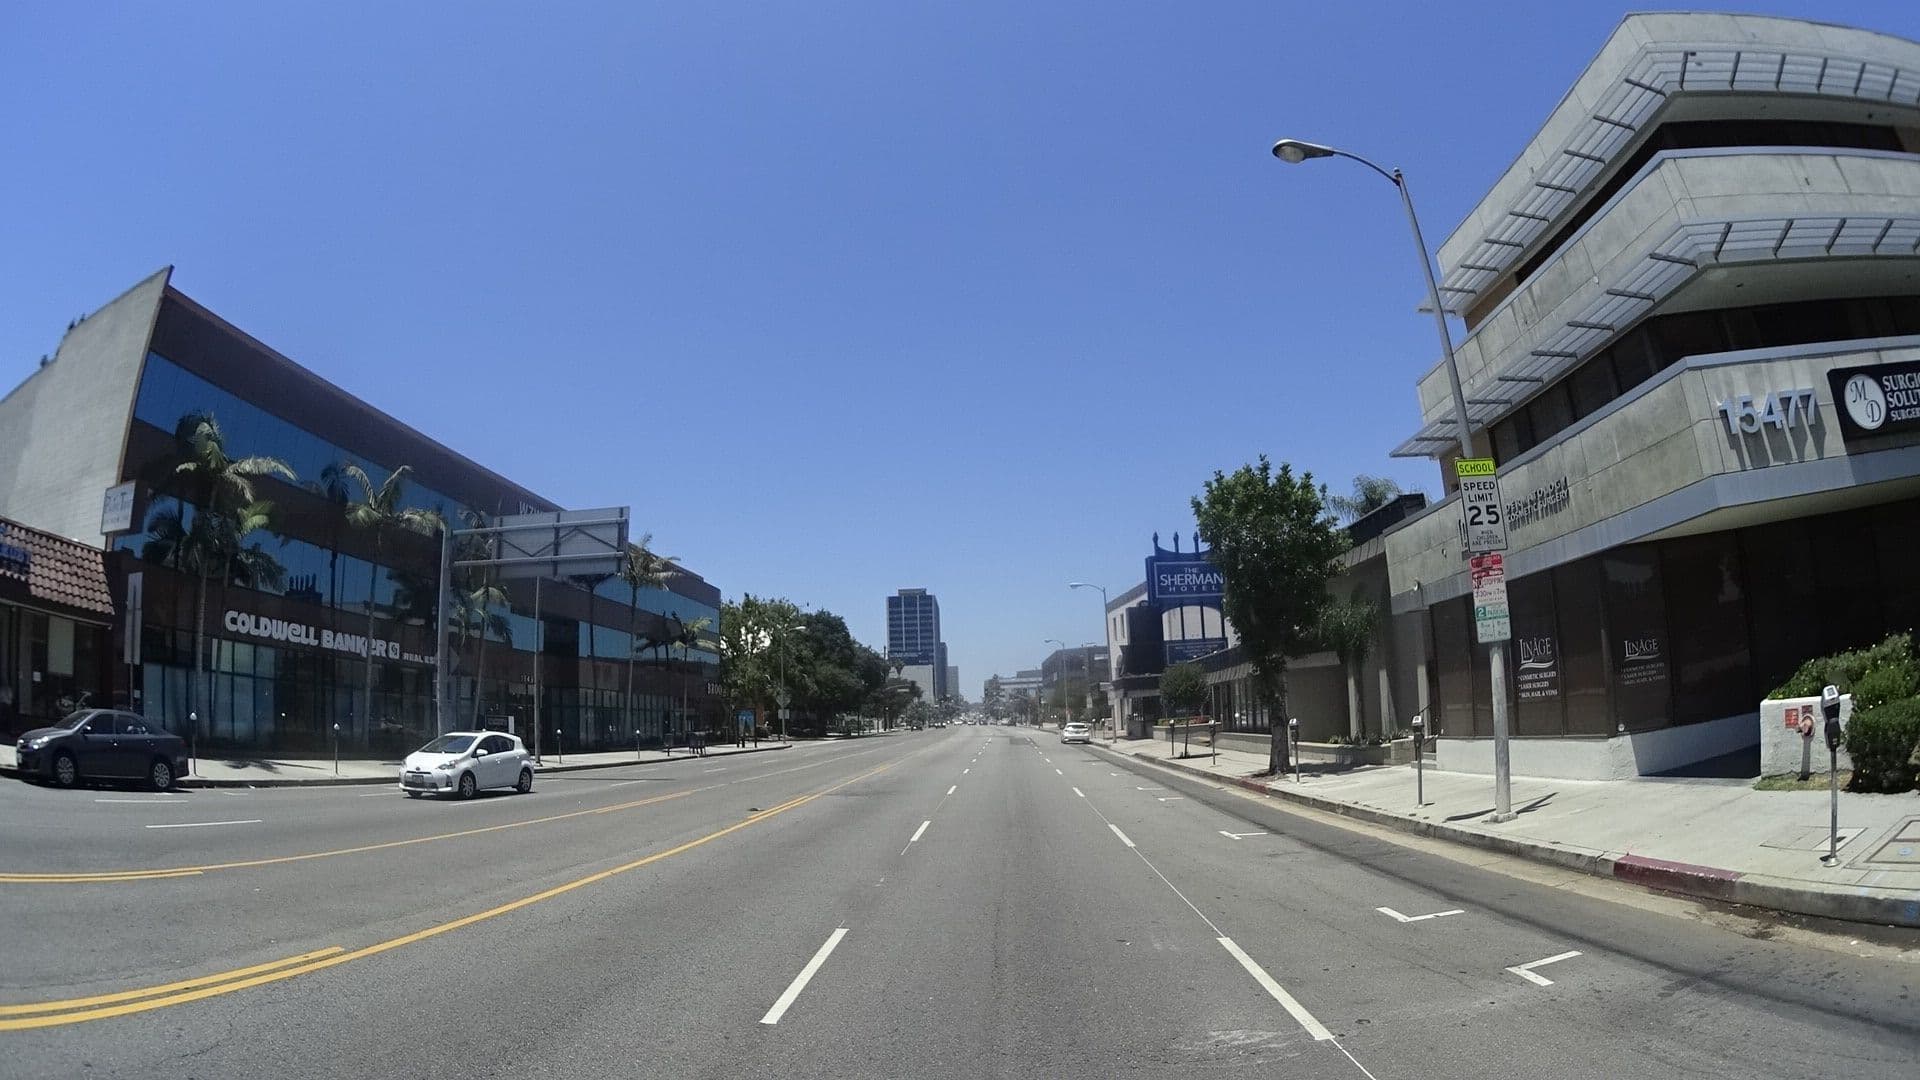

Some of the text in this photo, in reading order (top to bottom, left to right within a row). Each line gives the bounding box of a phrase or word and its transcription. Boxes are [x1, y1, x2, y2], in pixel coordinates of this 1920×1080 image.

[1718, 387, 1816, 435] 15477
[1459, 463, 1494, 474] SCHOOL
[1463, 481, 1496, 491] SPEED
[1468, 493, 1494, 503] LIMIT
[1468, 504, 1500, 526] 25
[1160, 573, 1224, 586] SHERMAN
